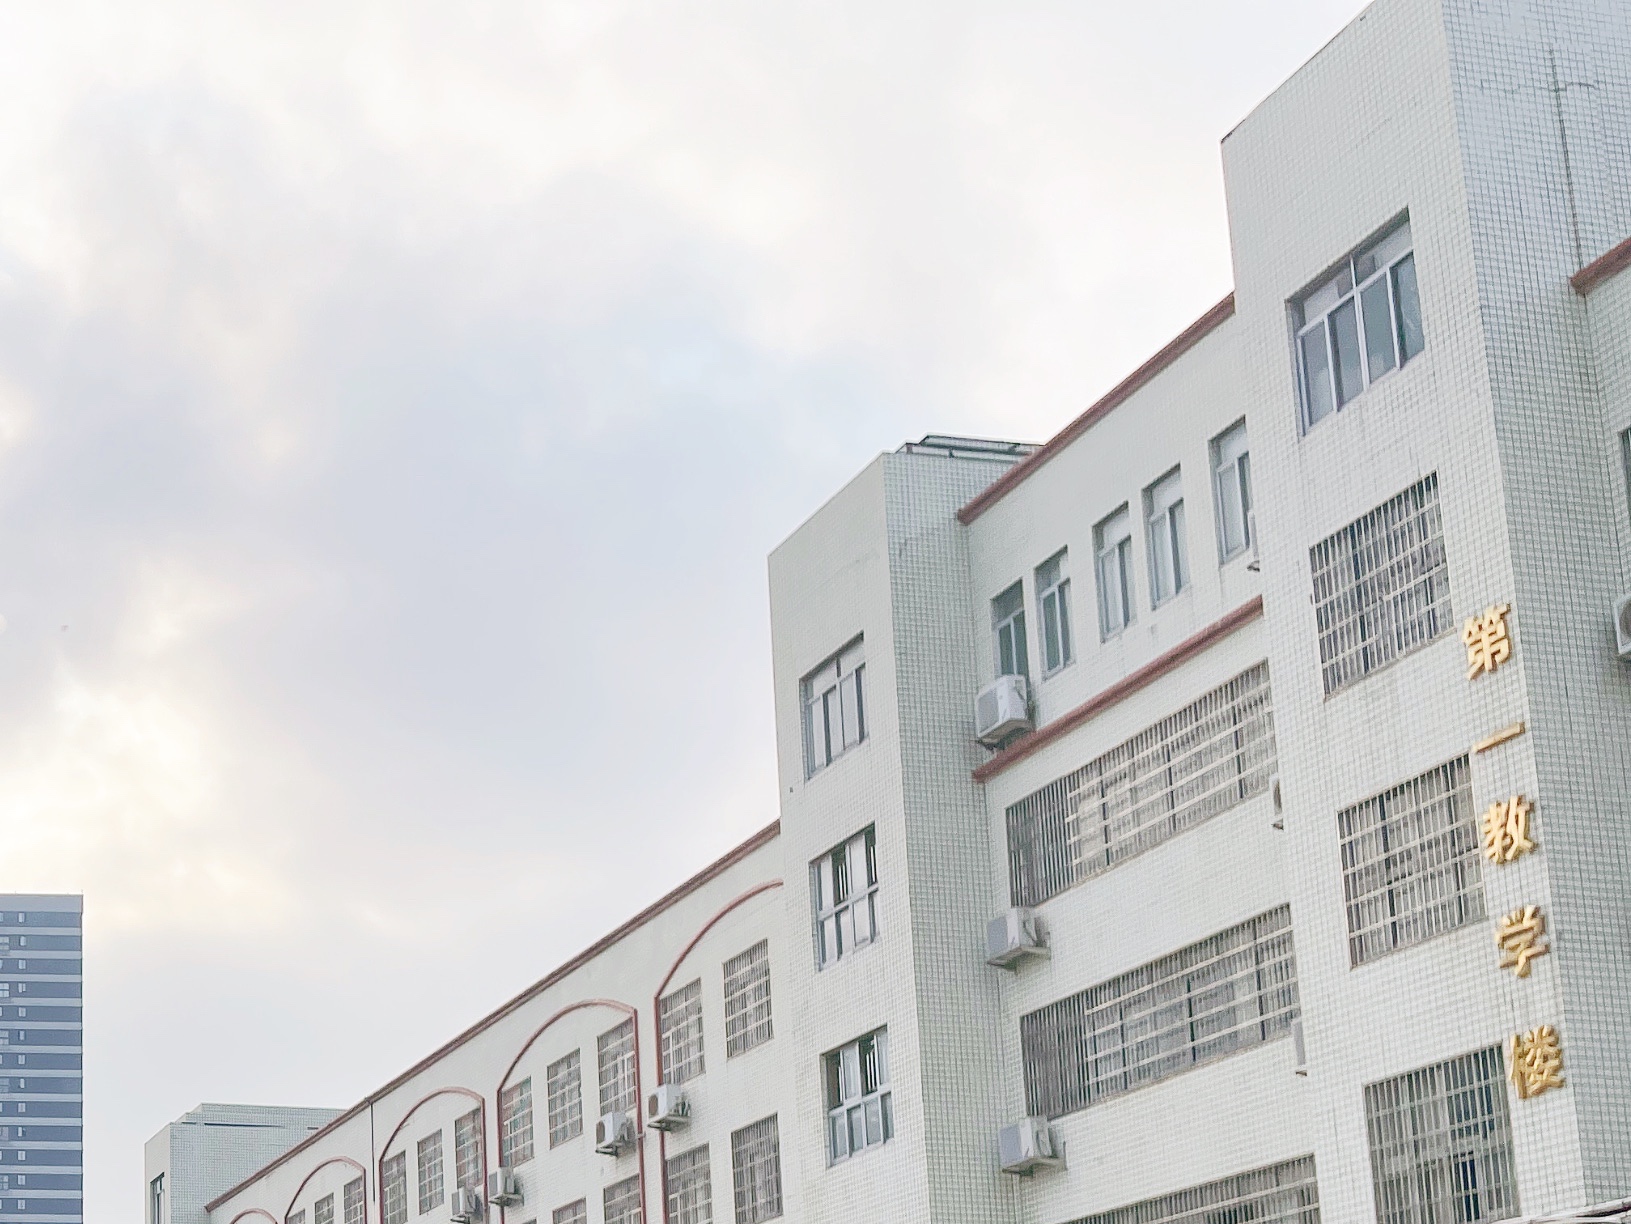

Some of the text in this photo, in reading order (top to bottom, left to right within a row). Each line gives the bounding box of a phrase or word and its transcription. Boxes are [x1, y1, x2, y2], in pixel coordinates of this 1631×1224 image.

[1462, 603, 1566, 1099] 第一教学楼
